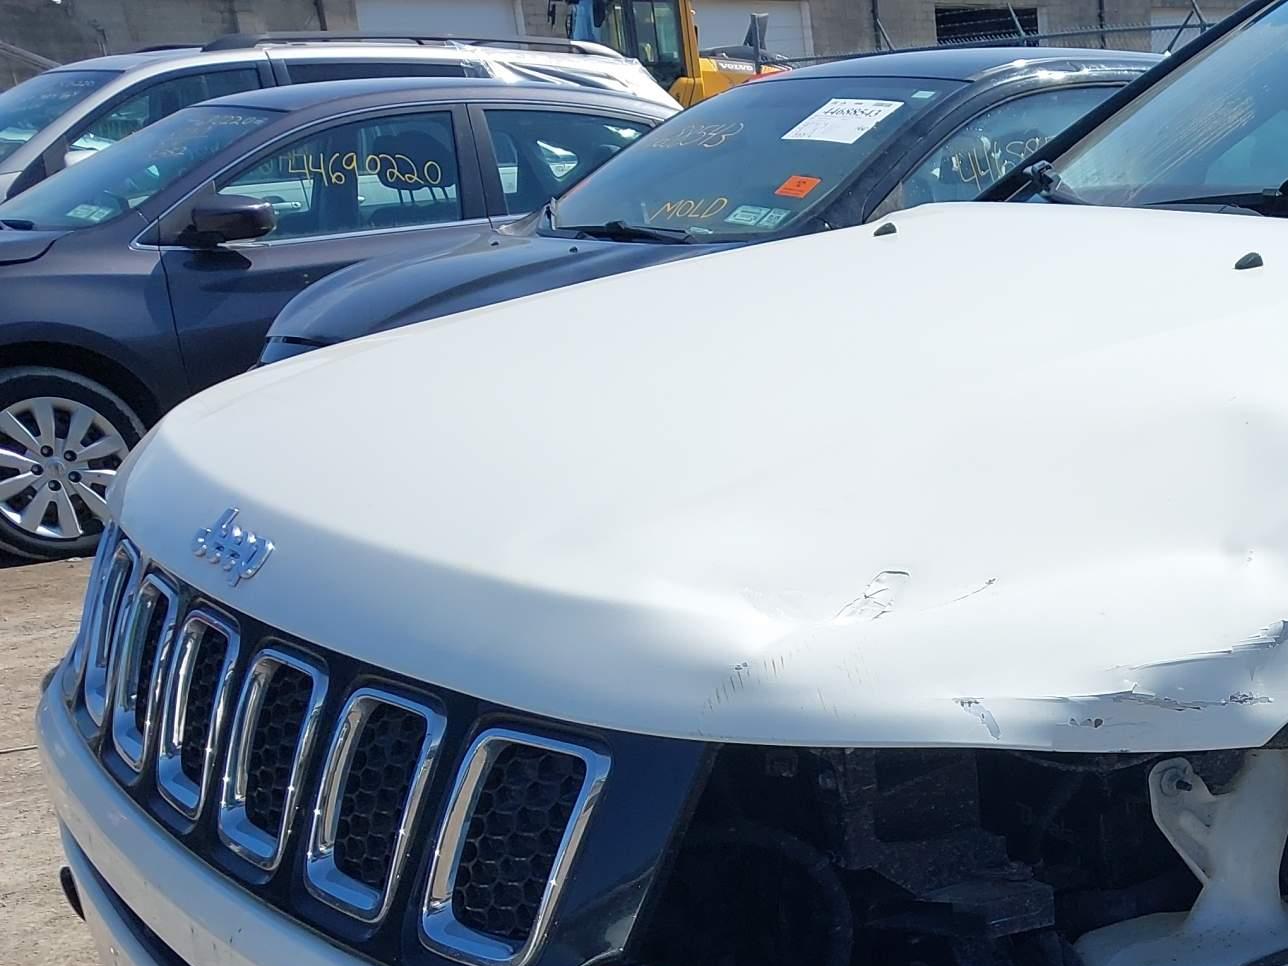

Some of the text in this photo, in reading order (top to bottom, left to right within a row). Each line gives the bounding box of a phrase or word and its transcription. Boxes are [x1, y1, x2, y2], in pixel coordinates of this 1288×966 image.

[719, 62, 754, 71] VOLVO
[288, 152, 441, 187] 44690220
[648, 197, 728, 222] MOLD
[191, 506, 274, 588] Jeep
